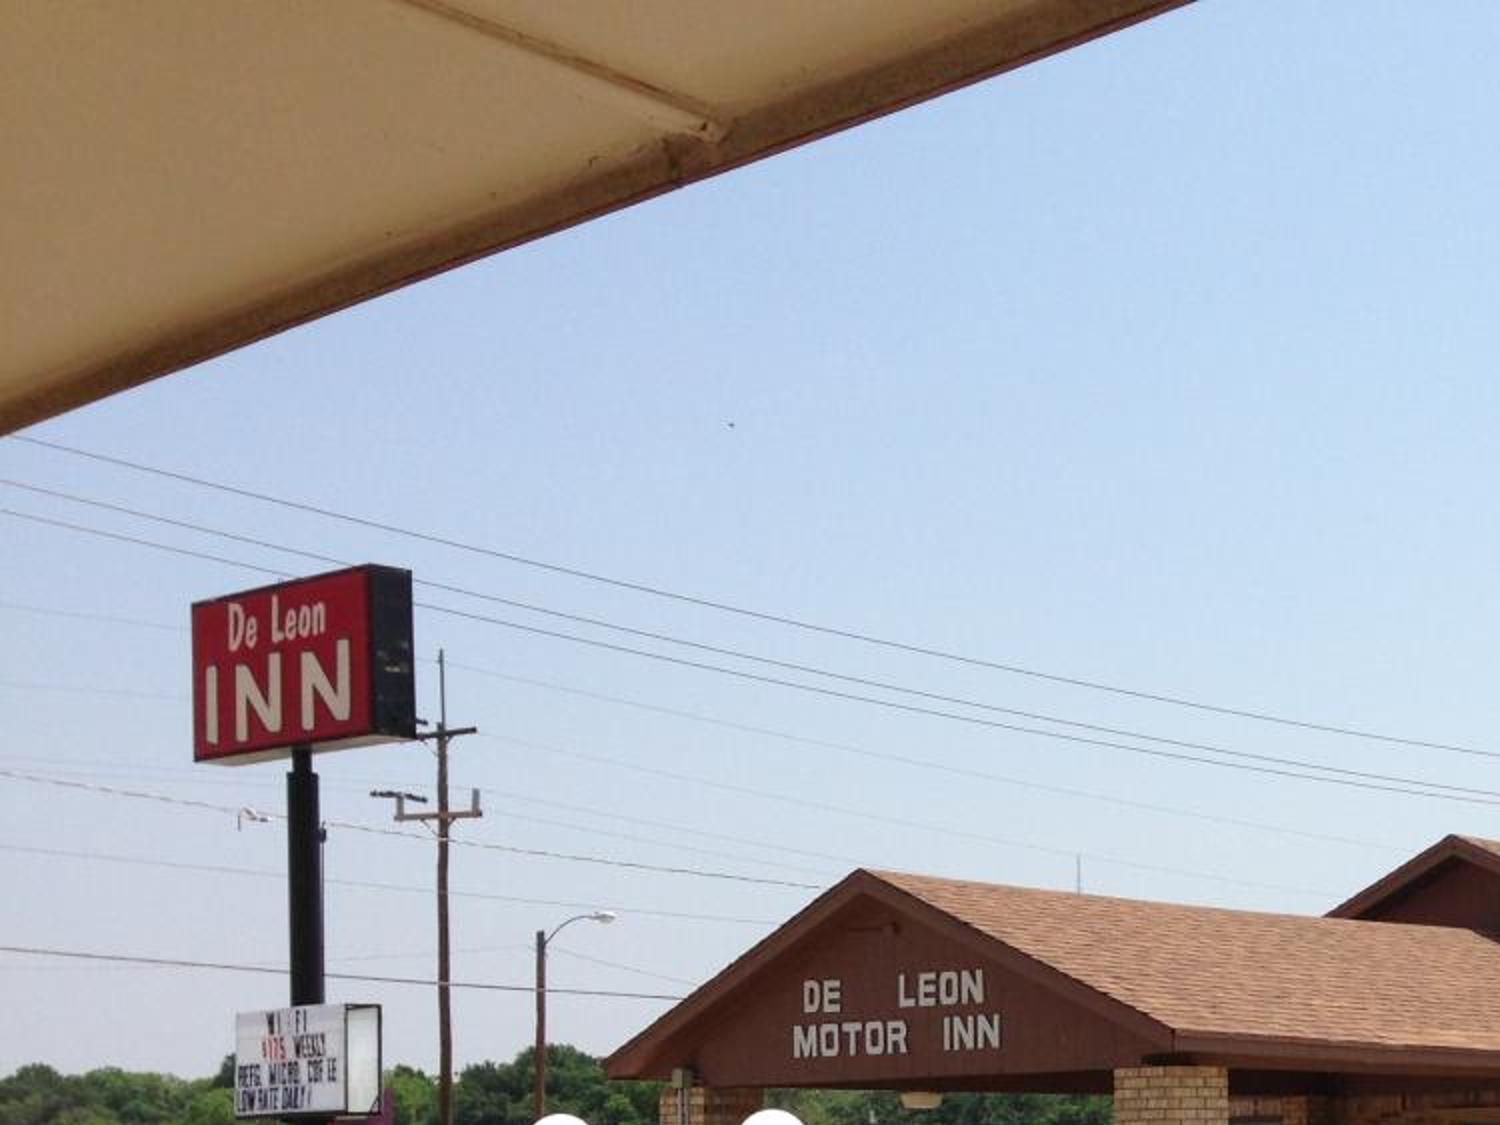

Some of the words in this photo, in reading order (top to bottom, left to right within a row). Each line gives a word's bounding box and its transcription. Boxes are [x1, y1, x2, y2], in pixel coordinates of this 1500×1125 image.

[227, 602, 258, 652] De
[271, 594, 326, 643] Leon
[205, 639, 350, 745] INN
[803, 979, 841, 1013] DE
[899, 968, 984, 1009] LEON
[293, 1032, 326, 1058] WEEKLY
[793, 1019, 908, 1059] MOTOR
[943, 1013, 1000, 1052] INN
[237, 1088, 255, 1113] LOW
